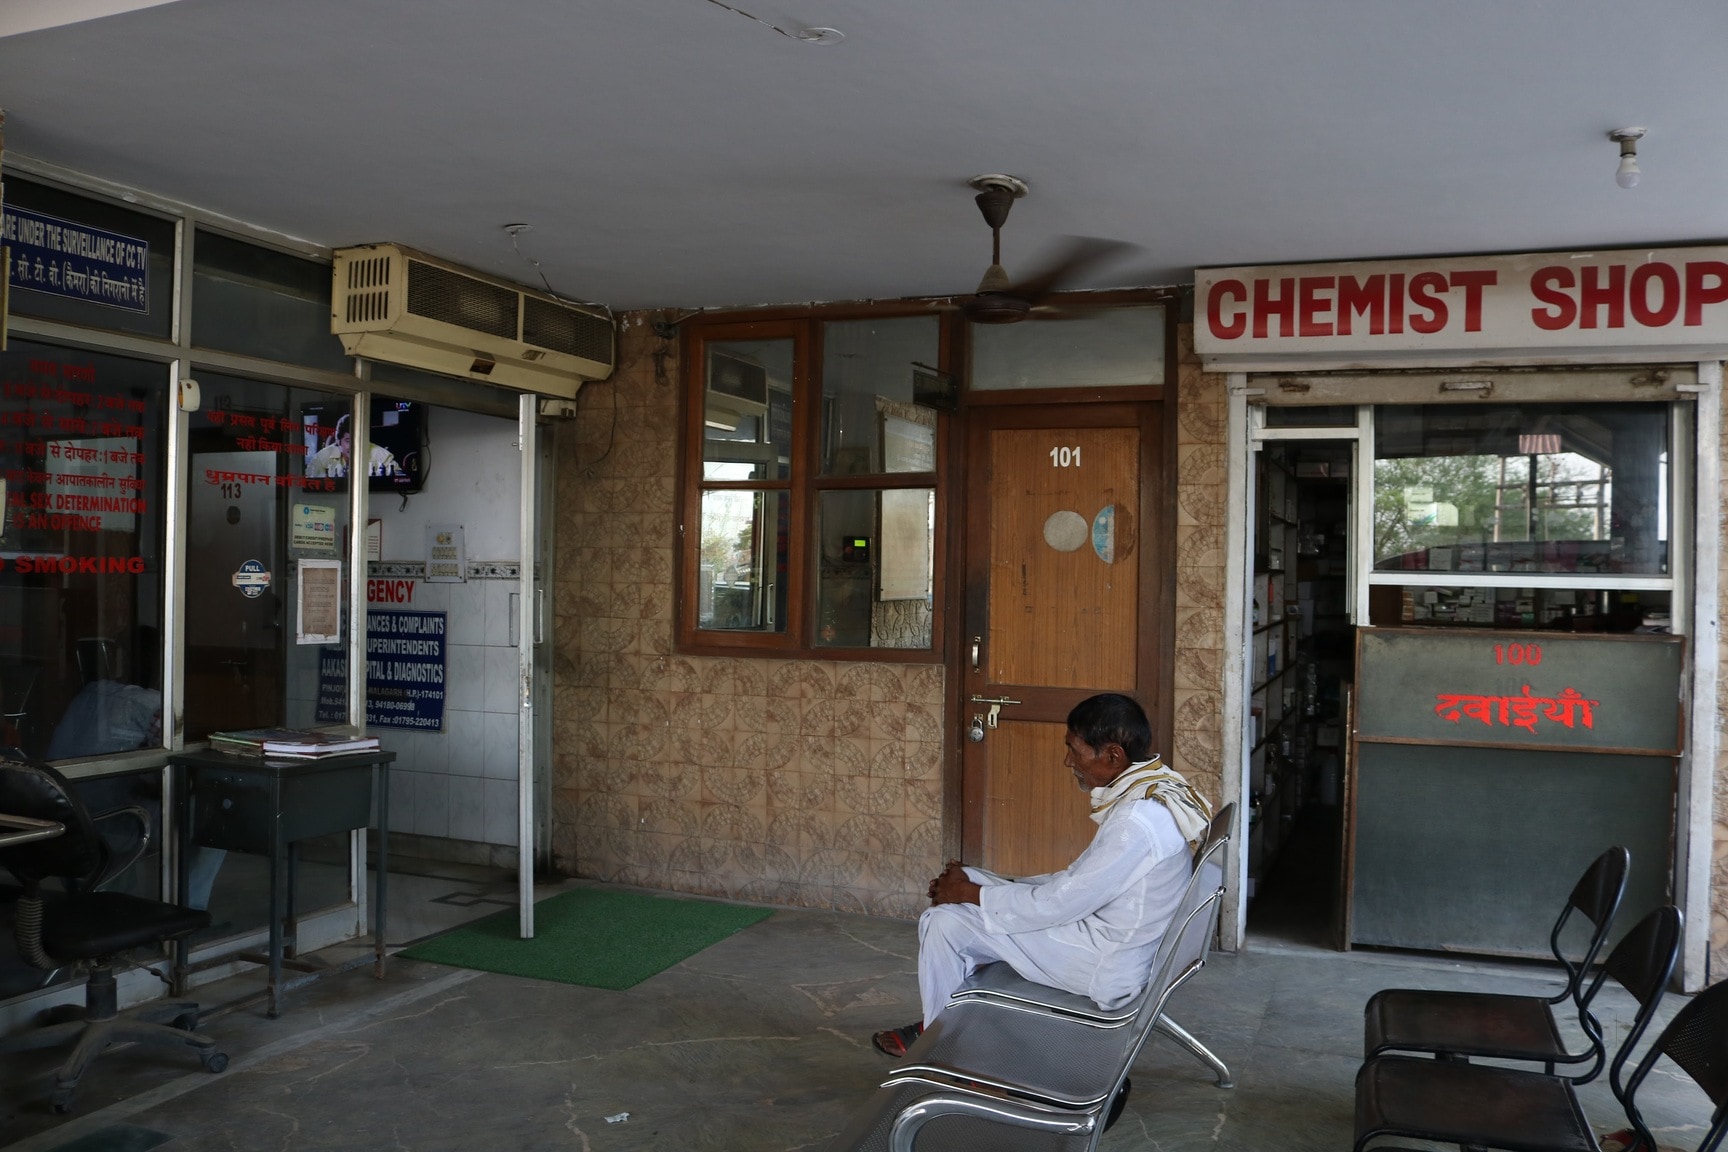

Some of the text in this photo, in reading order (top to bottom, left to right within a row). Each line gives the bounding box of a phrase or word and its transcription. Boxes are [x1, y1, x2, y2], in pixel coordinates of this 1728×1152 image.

[18, 217, 45, 248] UNDER
[46, 223, 62, 252] THE
[62, 227, 115, 264] SURVEILLANCE
[116, 241, 126, 266] OF
[126, 243, 136, 269] CC
[136, 246, 146, 271] TV
[101, 270, 131, 302] निगरानी
[1207, 261, 1728, 340] CHEMIST SHOP
[50, 441, 62, 458] से
[110, 446, 128, 464] बजे
[1050, 446, 1081, 467] 101
[57, 473, 115, 488] आपातकालीन
[221, 482, 241, 499] 113
[30, 492, 52, 509] SEX
[57, 494, 147, 513] DETERMINATION
[28, 513, 48, 529] AN
[51, 514, 102, 533] OFFENCE
[14, 555, 145, 574] SMOKING
[391, 615, 397, 632] &
[398, 616, 444, 635] COMPLAINTS
[1493, 642, 1542, 666] 100
[387, 661, 392, 681] &
[394, 661, 443, 684] DIAGNOSTICS
[379, 714, 391, 723] Fax
